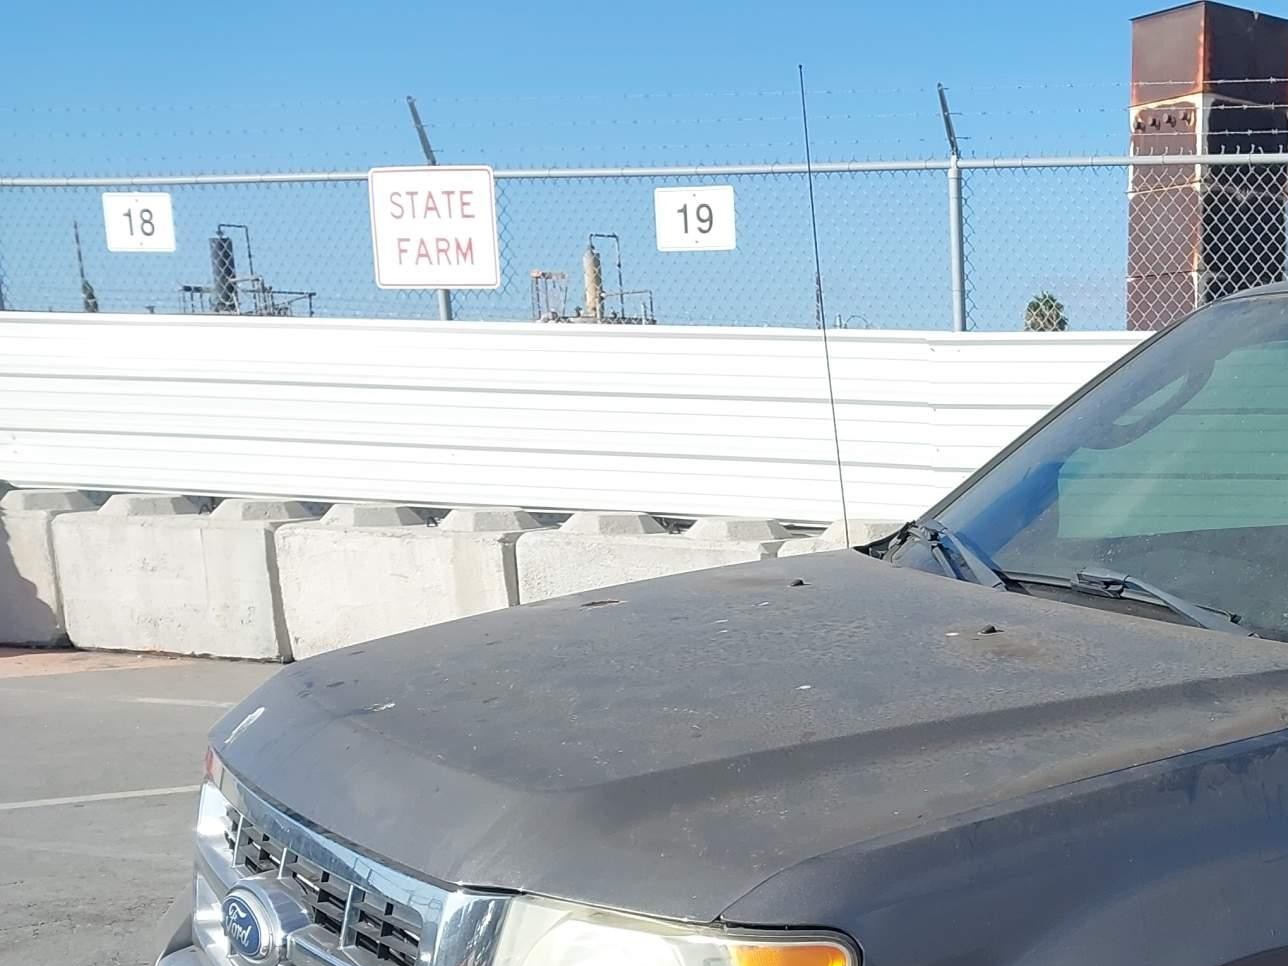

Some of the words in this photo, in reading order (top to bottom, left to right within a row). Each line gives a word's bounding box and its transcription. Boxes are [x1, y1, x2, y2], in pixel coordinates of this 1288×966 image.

[390, 189, 476, 221] STATE
[676, 203, 714, 235] 19
[122, 207, 156, 238] 18
[398, 237, 476, 267] FARM
[226, 902, 252, 947] Ford
